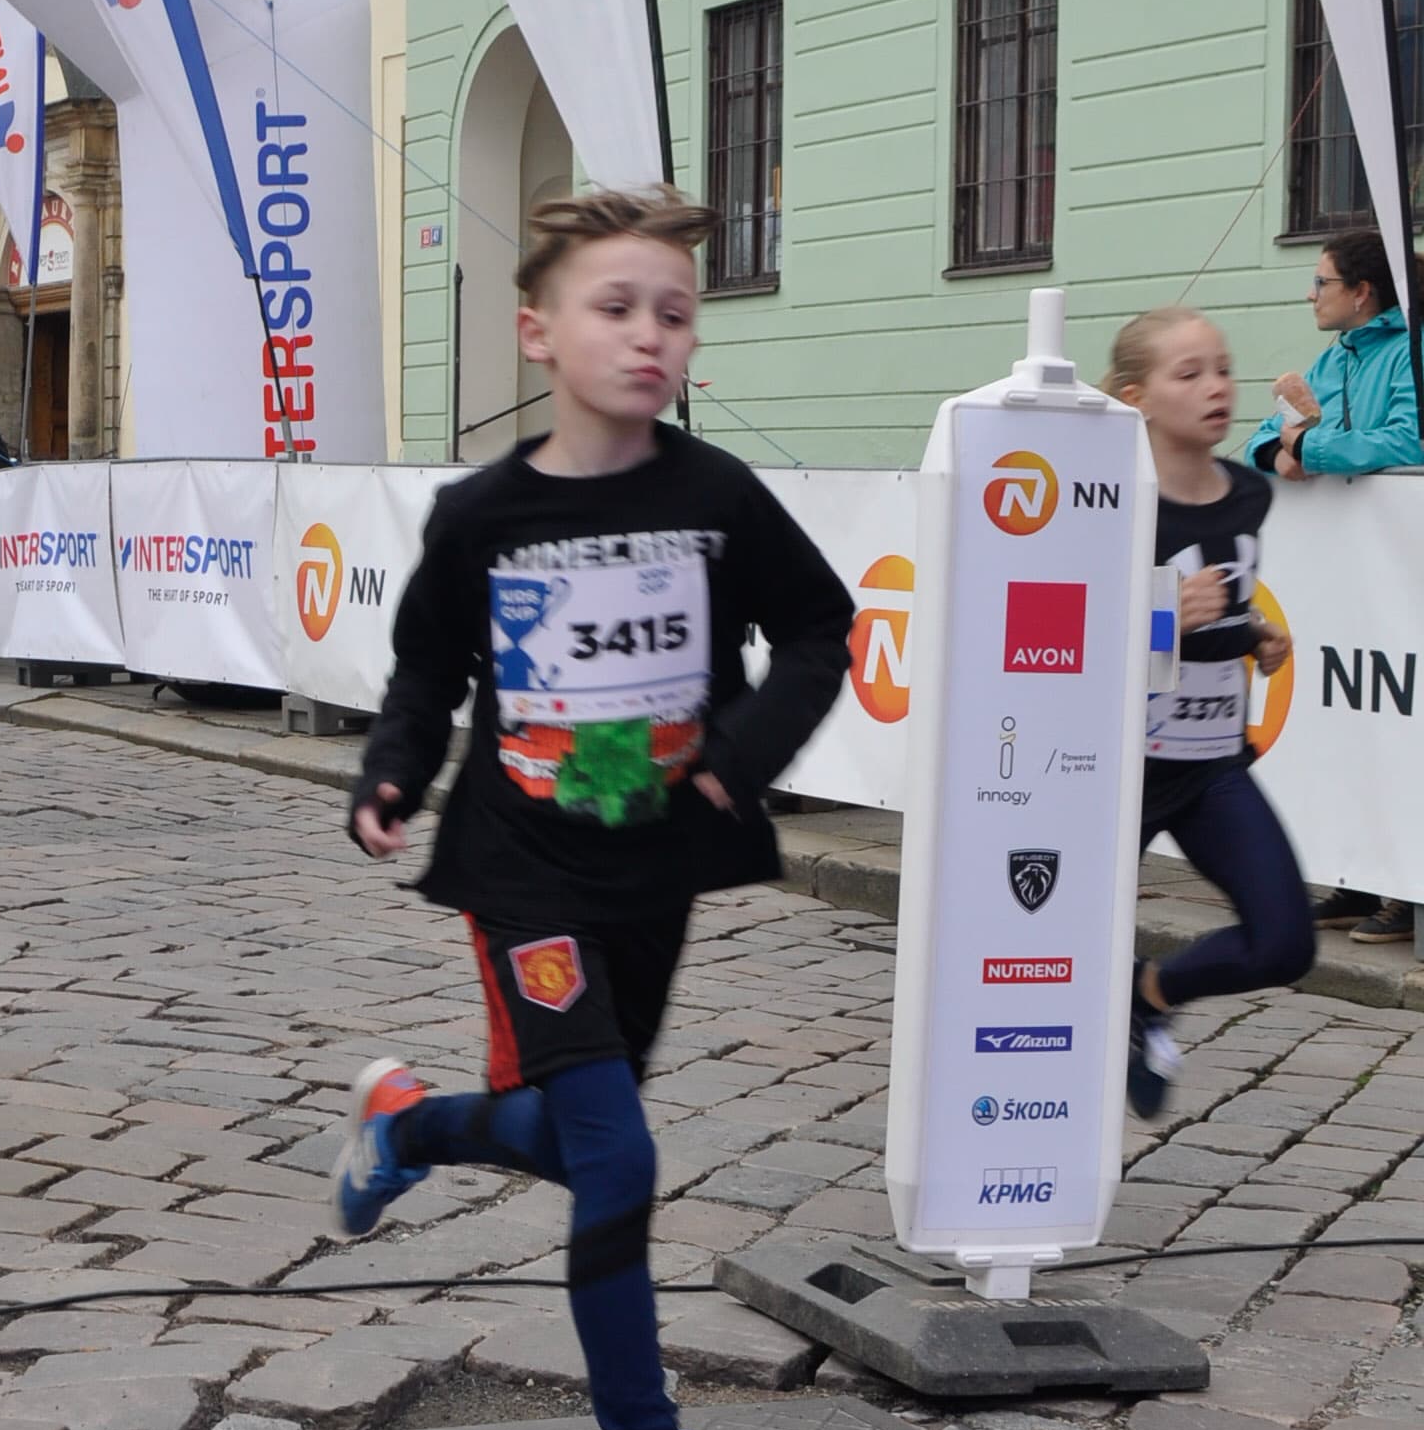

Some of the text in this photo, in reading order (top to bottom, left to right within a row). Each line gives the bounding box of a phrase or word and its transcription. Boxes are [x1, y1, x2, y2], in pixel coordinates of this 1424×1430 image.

[1073, 481, 1120, 509] NN
[134, 535, 253, 580] INTERSPORT
[193, 590, 229, 606] SPORT
[349, 567, 386, 607] NN
[569, 611, 691, 660] 3415
[1012, 648, 1075, 666] AVON
[1320, 645, 1417, 717] NN
[1061, 753, 1097, 762] Powered
[977, 787, 1032, 805] innogy
[988, 963, 1069, 979] NUTREND
[1002, 1098, 1069, 1121] ŠKODA
[978, 1182, 1054, 1204] KPMG
